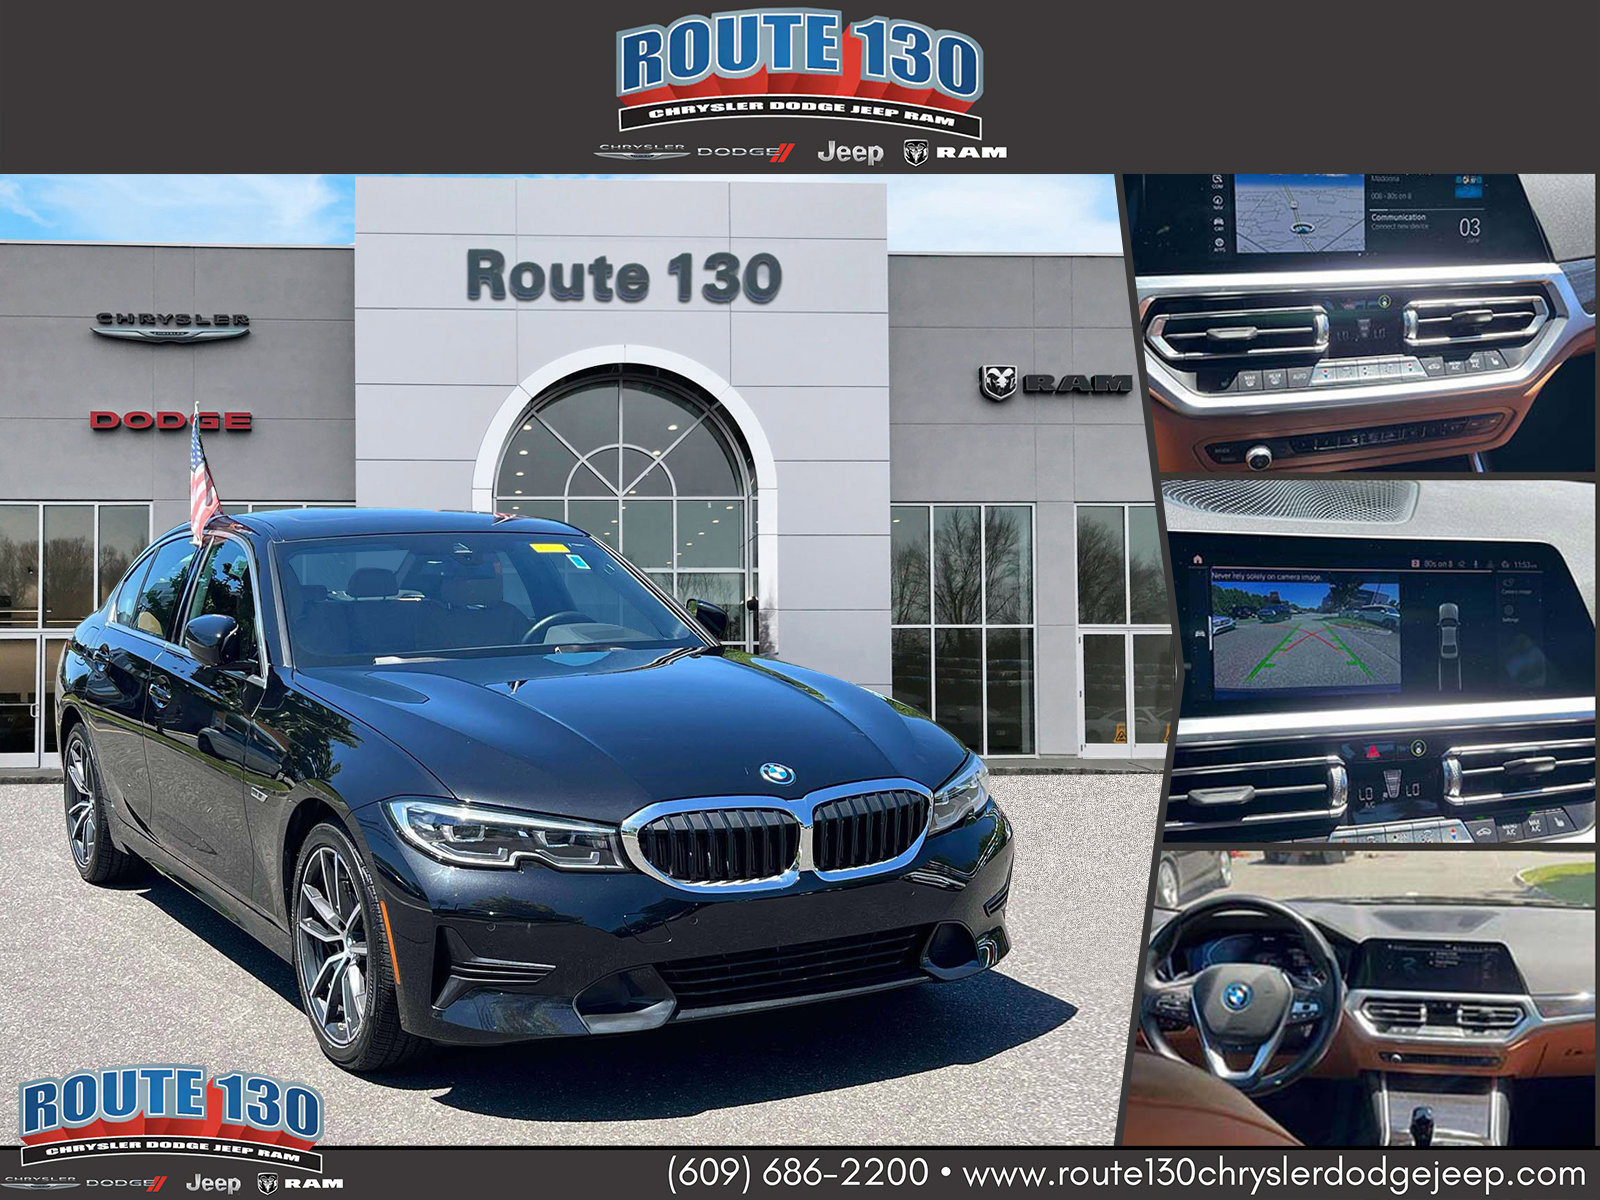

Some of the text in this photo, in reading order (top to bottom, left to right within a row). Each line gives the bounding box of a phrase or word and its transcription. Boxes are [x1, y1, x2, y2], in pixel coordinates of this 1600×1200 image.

[1371, 213, 1427, 221] Communication
[1459, 217, 1481, 236] 03
[467, 248, 783, 304] Route 130
[96, 312, 250, 326] CHRYSLER
[1022, 374, 1133, 394] RAM
[90, 411, 252, 431] DODGE
[1358, 783, 1420, 801] LO LO
